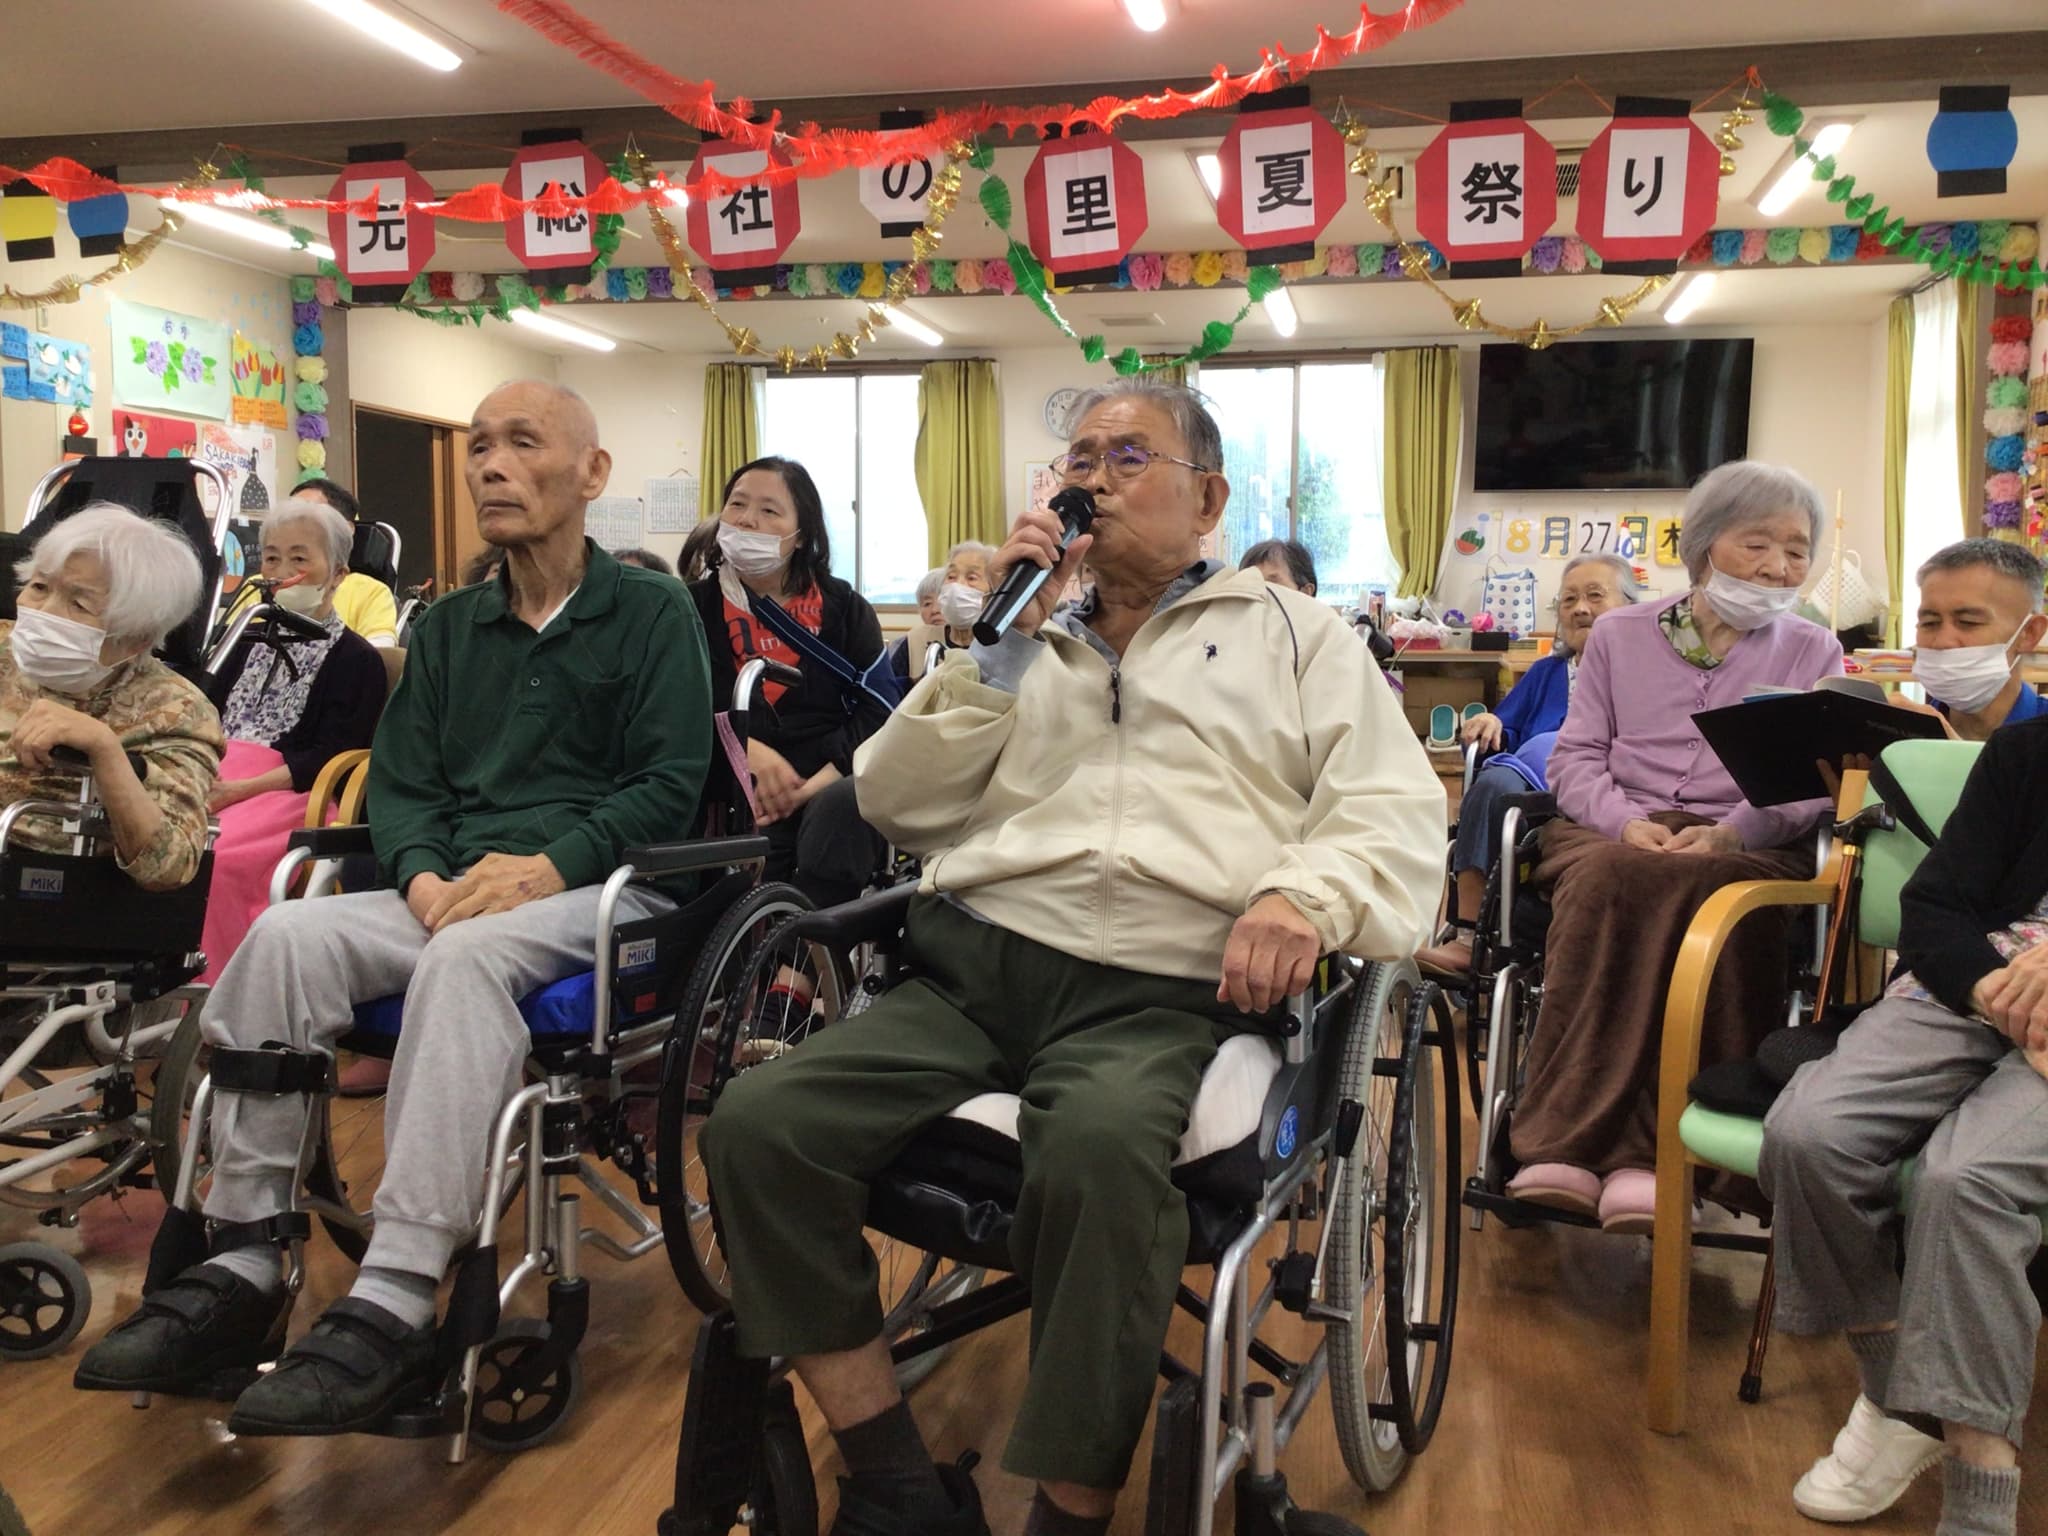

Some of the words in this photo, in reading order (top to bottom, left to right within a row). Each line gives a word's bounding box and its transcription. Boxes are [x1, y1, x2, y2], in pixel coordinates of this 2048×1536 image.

[358, 204, 406, 254] 元
[720, 181, 773, 234] 社
[882, 153, 932, 202] の
[1062, 174, 1116, 235] 里
[1255, 149, 1312, 213] 夏
[1461, 161, 1522, 224] 祭
[1623, 156, 1663, 216] り
